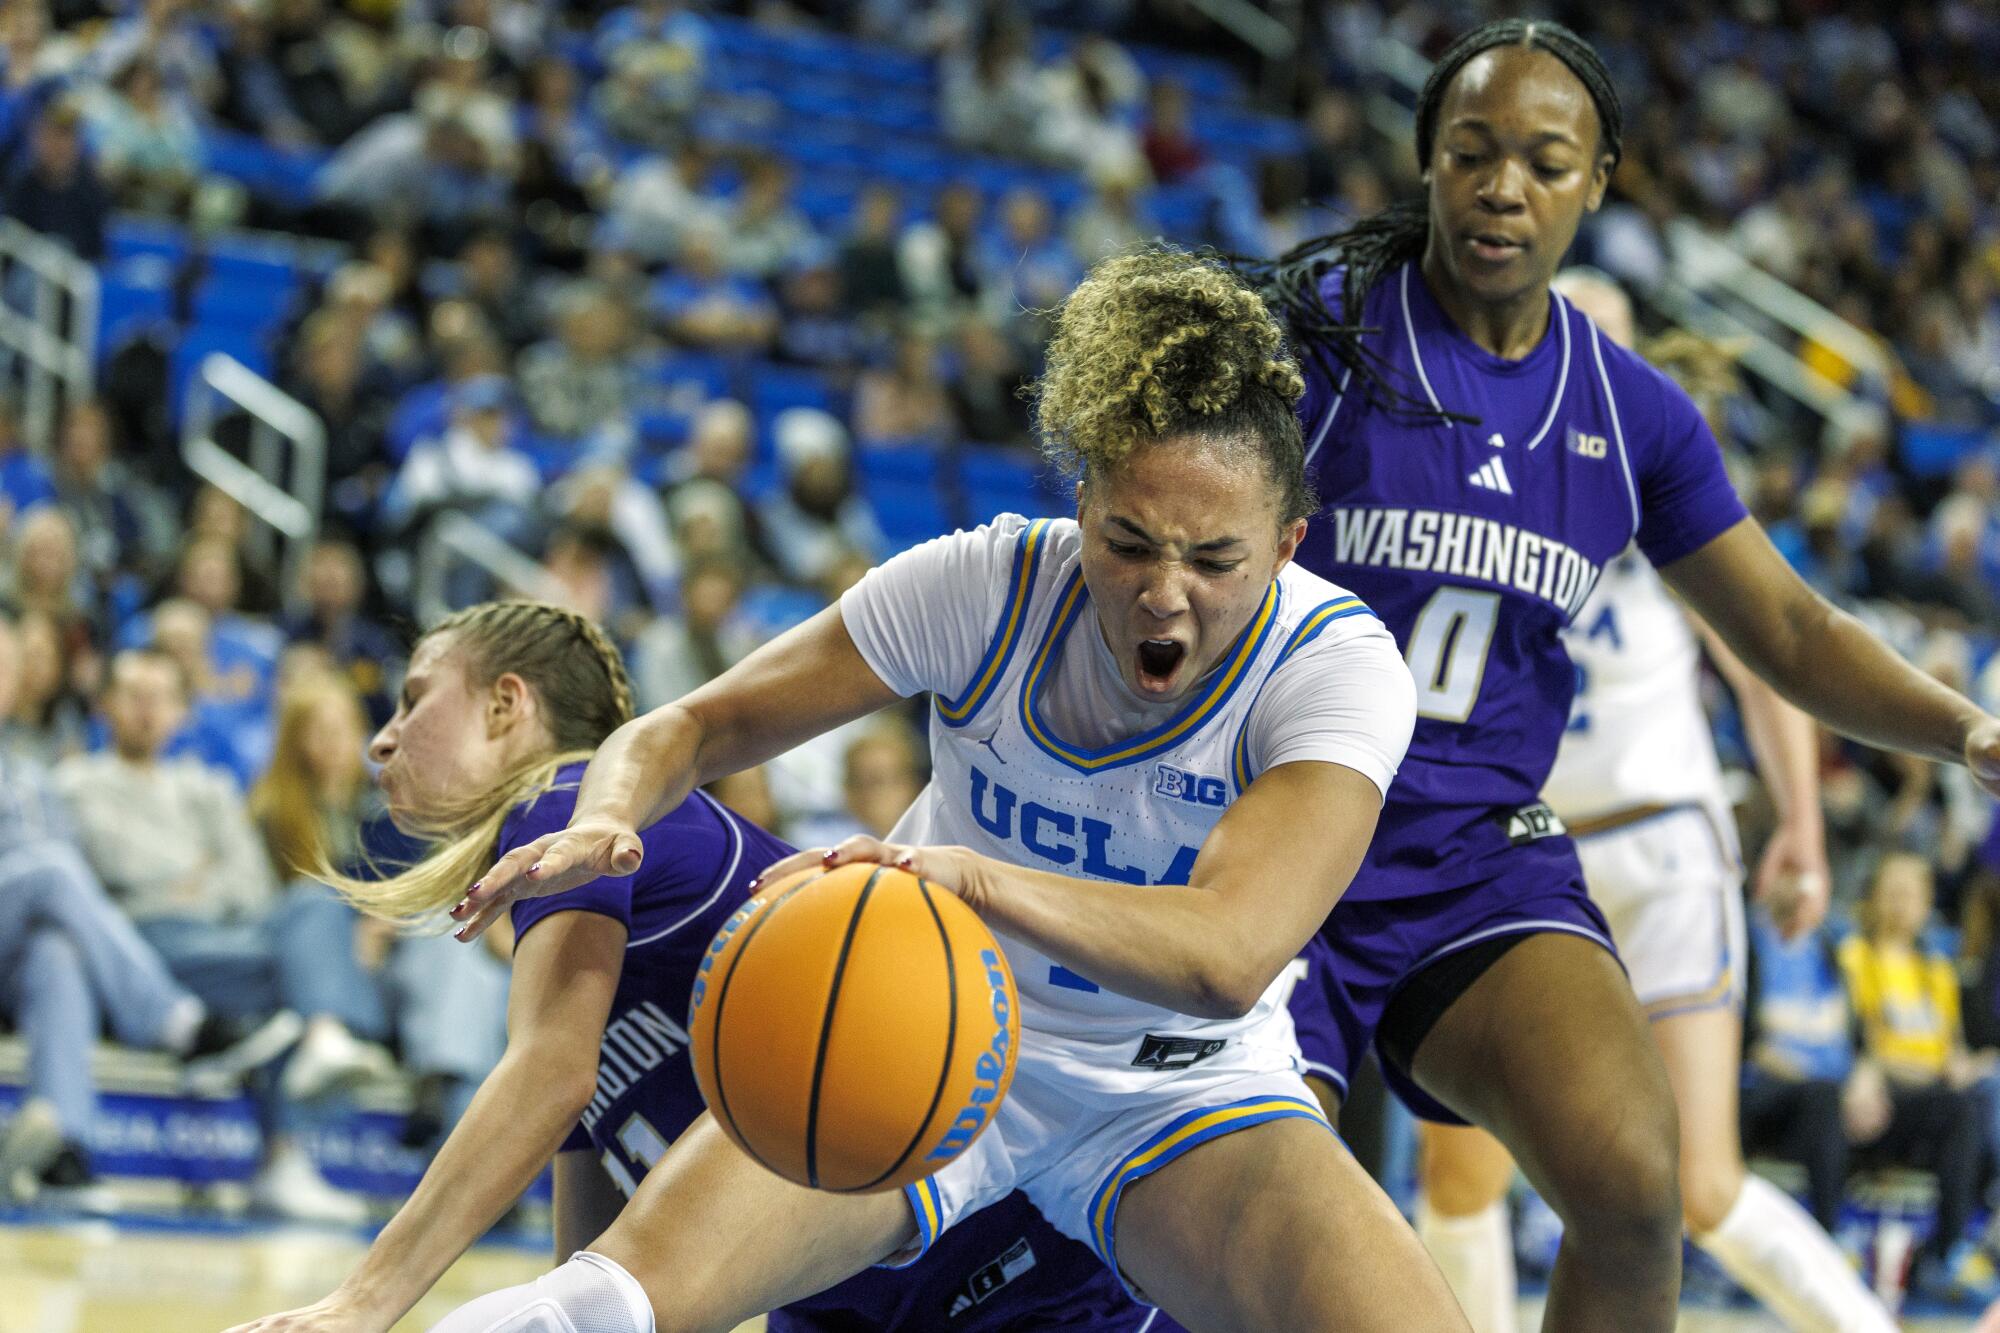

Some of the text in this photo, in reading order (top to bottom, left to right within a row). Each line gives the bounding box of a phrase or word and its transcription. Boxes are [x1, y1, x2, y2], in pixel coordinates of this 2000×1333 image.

[1335, 508, 1599, 619] WASHINGTON
[1404, 584, 1502, 724] 0
[923, 949, 1010, 1162] Wilson
